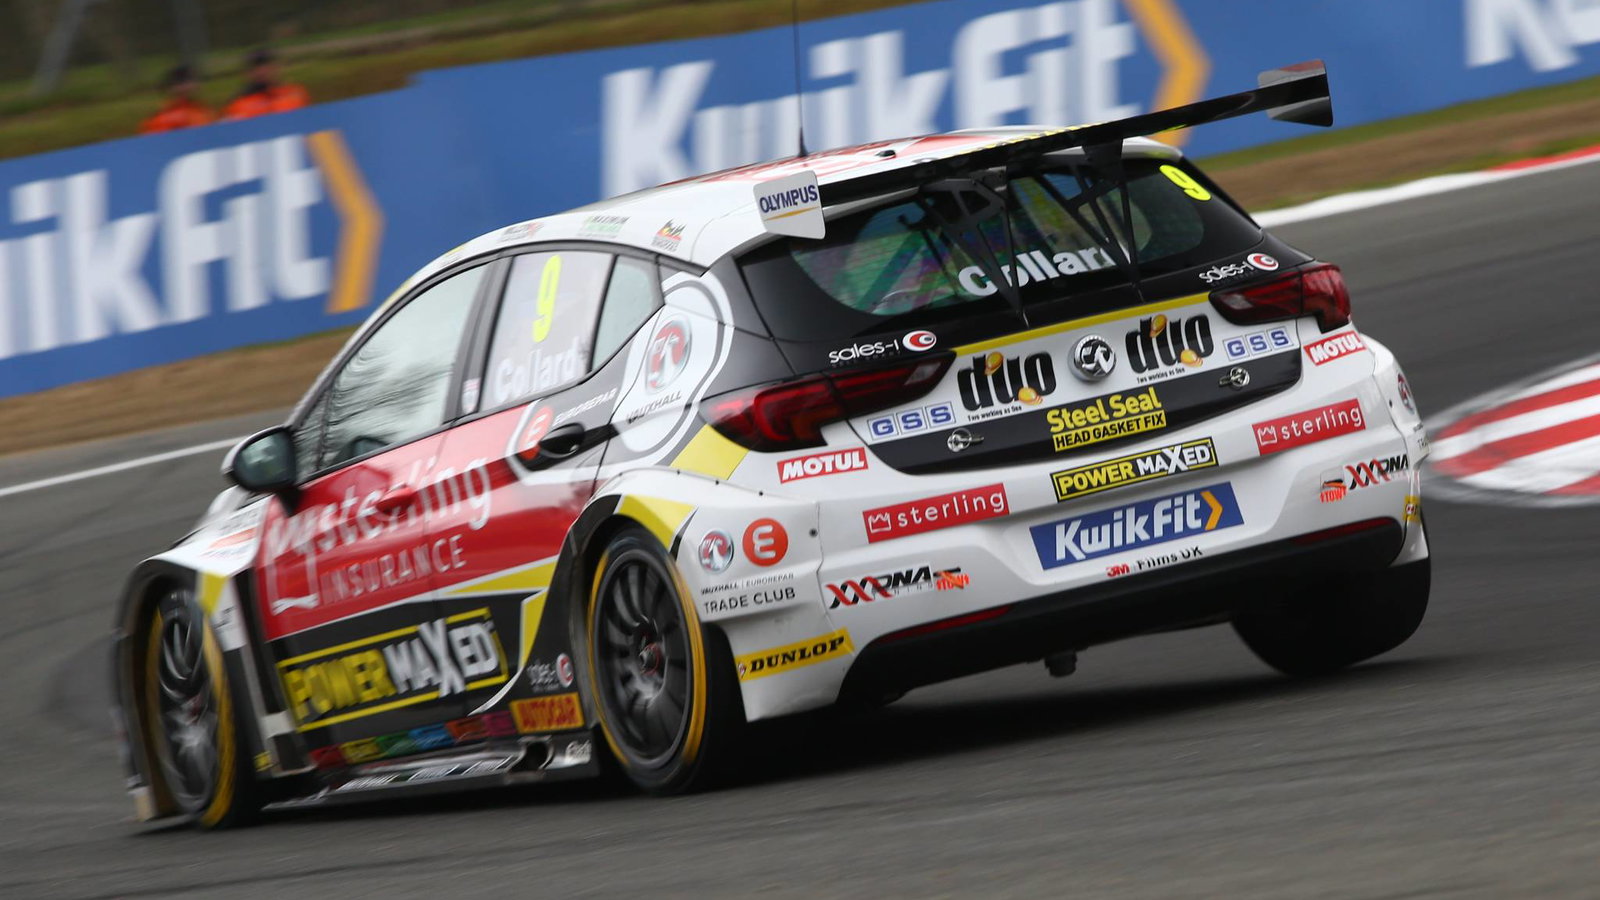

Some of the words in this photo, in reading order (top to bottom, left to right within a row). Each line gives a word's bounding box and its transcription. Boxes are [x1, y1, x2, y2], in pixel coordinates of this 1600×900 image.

[760, 184, 818, 213] OLYMPUS
[1159, 165, 1211, 200] 9
[532, 254, 562, 343] 9
[1125, 313, 1214, 374] duo
[1227, 330, 1289, 357] GSS
[1309, 333, 1363, 364] MOTUL
[493, 336, 588, 403] Collard
[957, 351, 1057, 411] duo
[626, 391, 682, 424] VAUXHALL
[872, 406, 951, 436] GSS
[1046, 398, 1109, 433] Steel
[1109, 386, 1162, 418] Seal
[1282, 405, 1362, 440] sterling
[1055, 429, 1091, 449] HEAD
[1093, 418, 1141, 440] GASKET
[1144, 413, 1164, 429] FIX
[782, 451, 865, 481] MOTUL
[1058, 461, 1136, 495] POWER
[897, 491, 1005, 528] sterling
[320, 534, 467, 605] INSURANCE
[1106, 563, 1130, 578] 3M
[1137, 553, 1178, 570] Films
[1180, 546, 1203, 559] UK
[701, 582, 738, 595] VAUXHALL
[703, 594, 749, 614] TRADE
[753, 587, 796, 605] CLUB
[750, 636, 845, 673] DUNLOP
[283, 649, 397, 720] POWER
